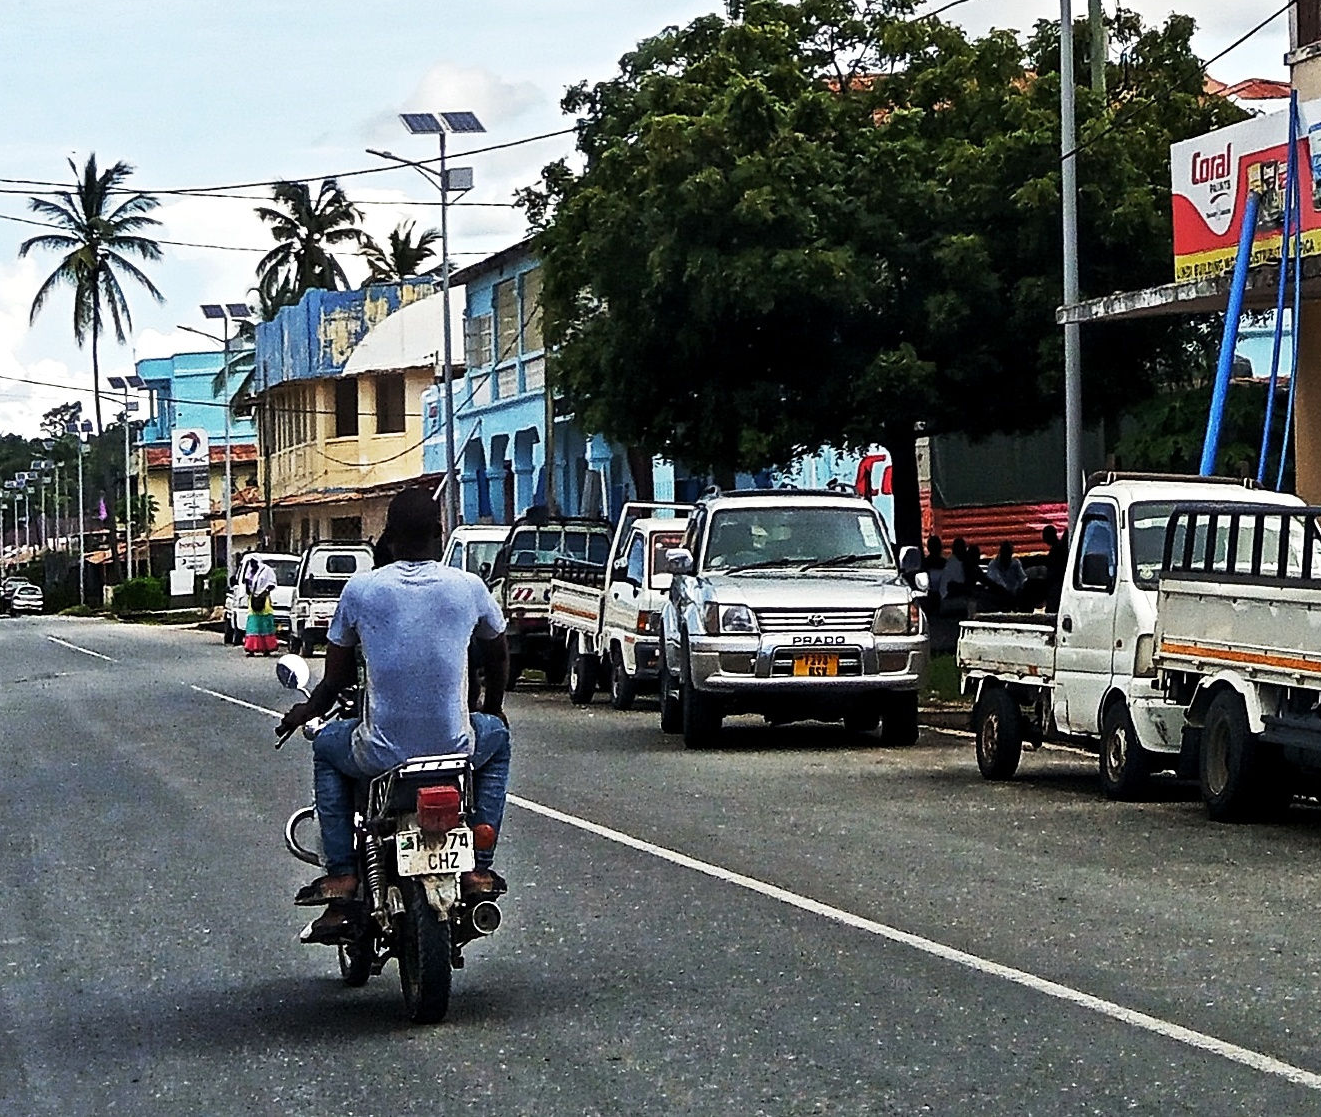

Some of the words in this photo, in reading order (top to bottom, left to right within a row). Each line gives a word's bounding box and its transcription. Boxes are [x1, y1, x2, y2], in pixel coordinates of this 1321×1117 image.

[1191, 142, 1232, 186] Coral
[1209, 179, 1231, 194] PAINTS
[792, 636, 846, 645] PRADO
[416, 832, 469, 852] M74
[428, 851, 460, 870] CHZ
